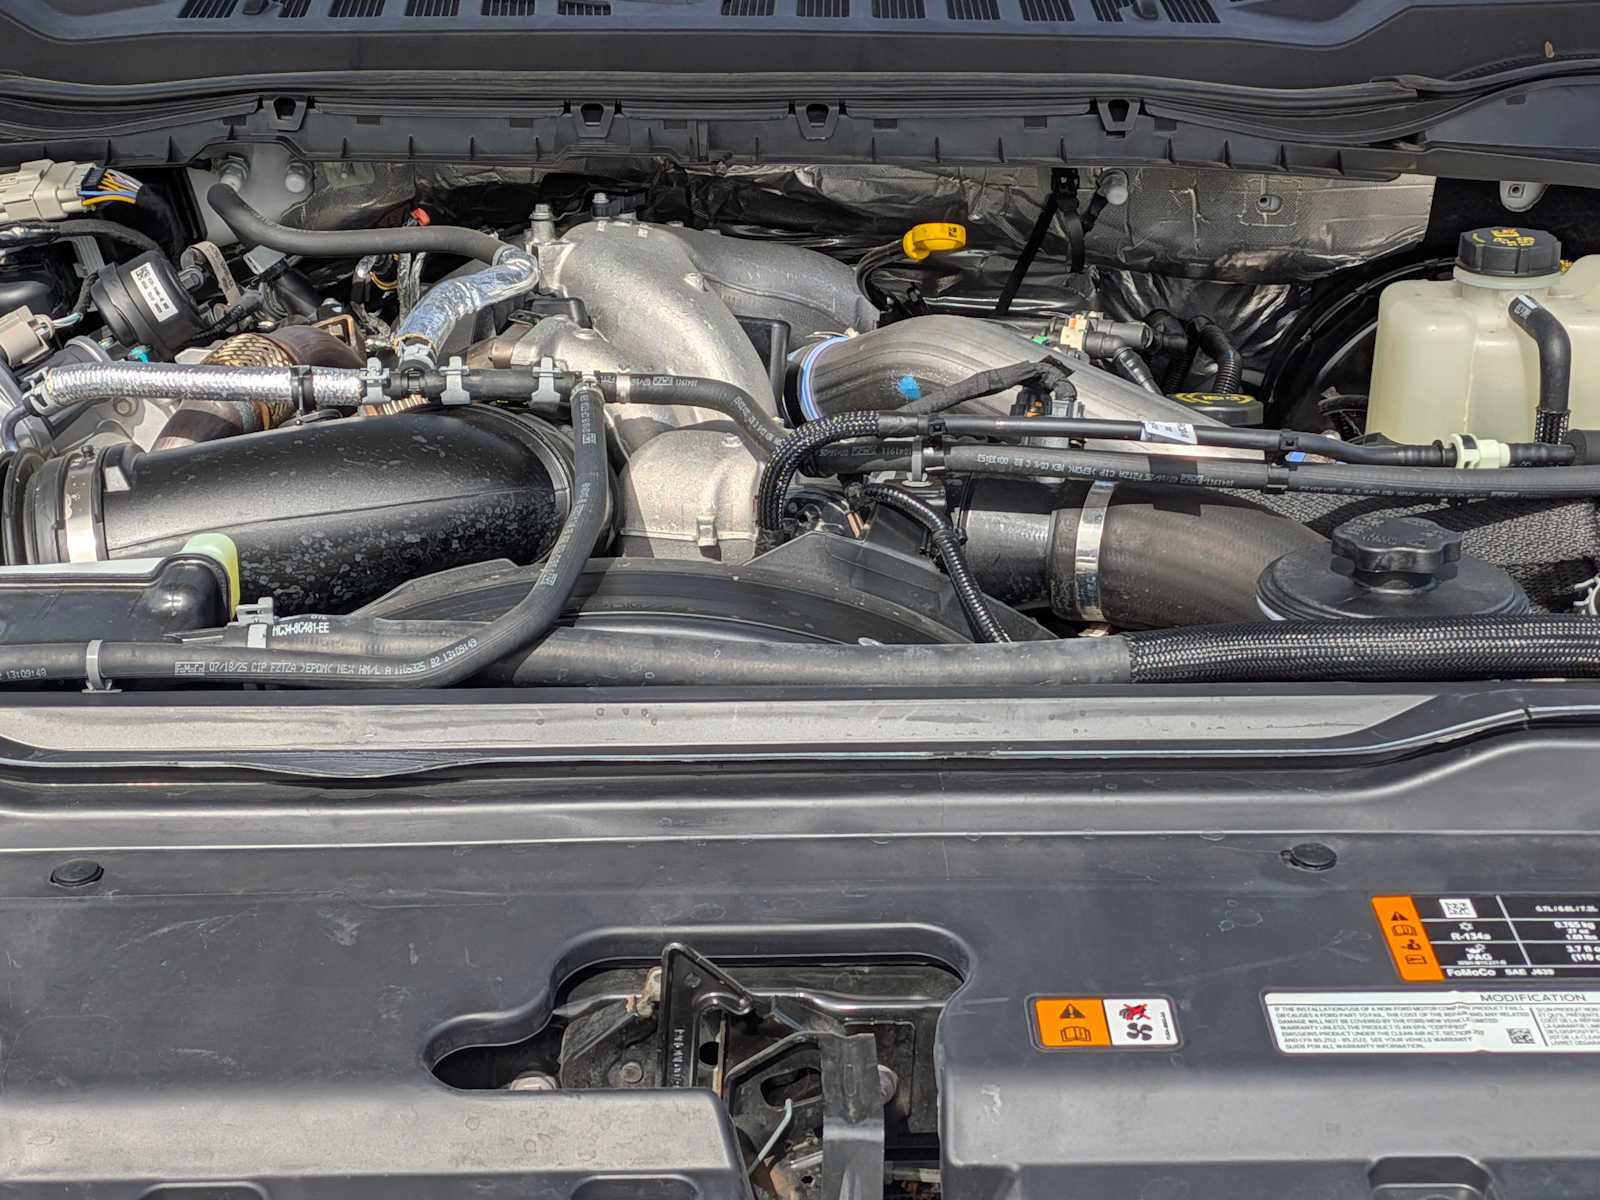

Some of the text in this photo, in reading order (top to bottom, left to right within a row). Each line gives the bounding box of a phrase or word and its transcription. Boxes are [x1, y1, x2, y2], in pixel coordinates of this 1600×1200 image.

[1450, 932, 1492, 940] R-134a
[1466, 953, 1493, 961] PAG
[1446, 968, 1496, 976] FoMoCo
[1480, 994, 1586, 1002] MODIFICATION
